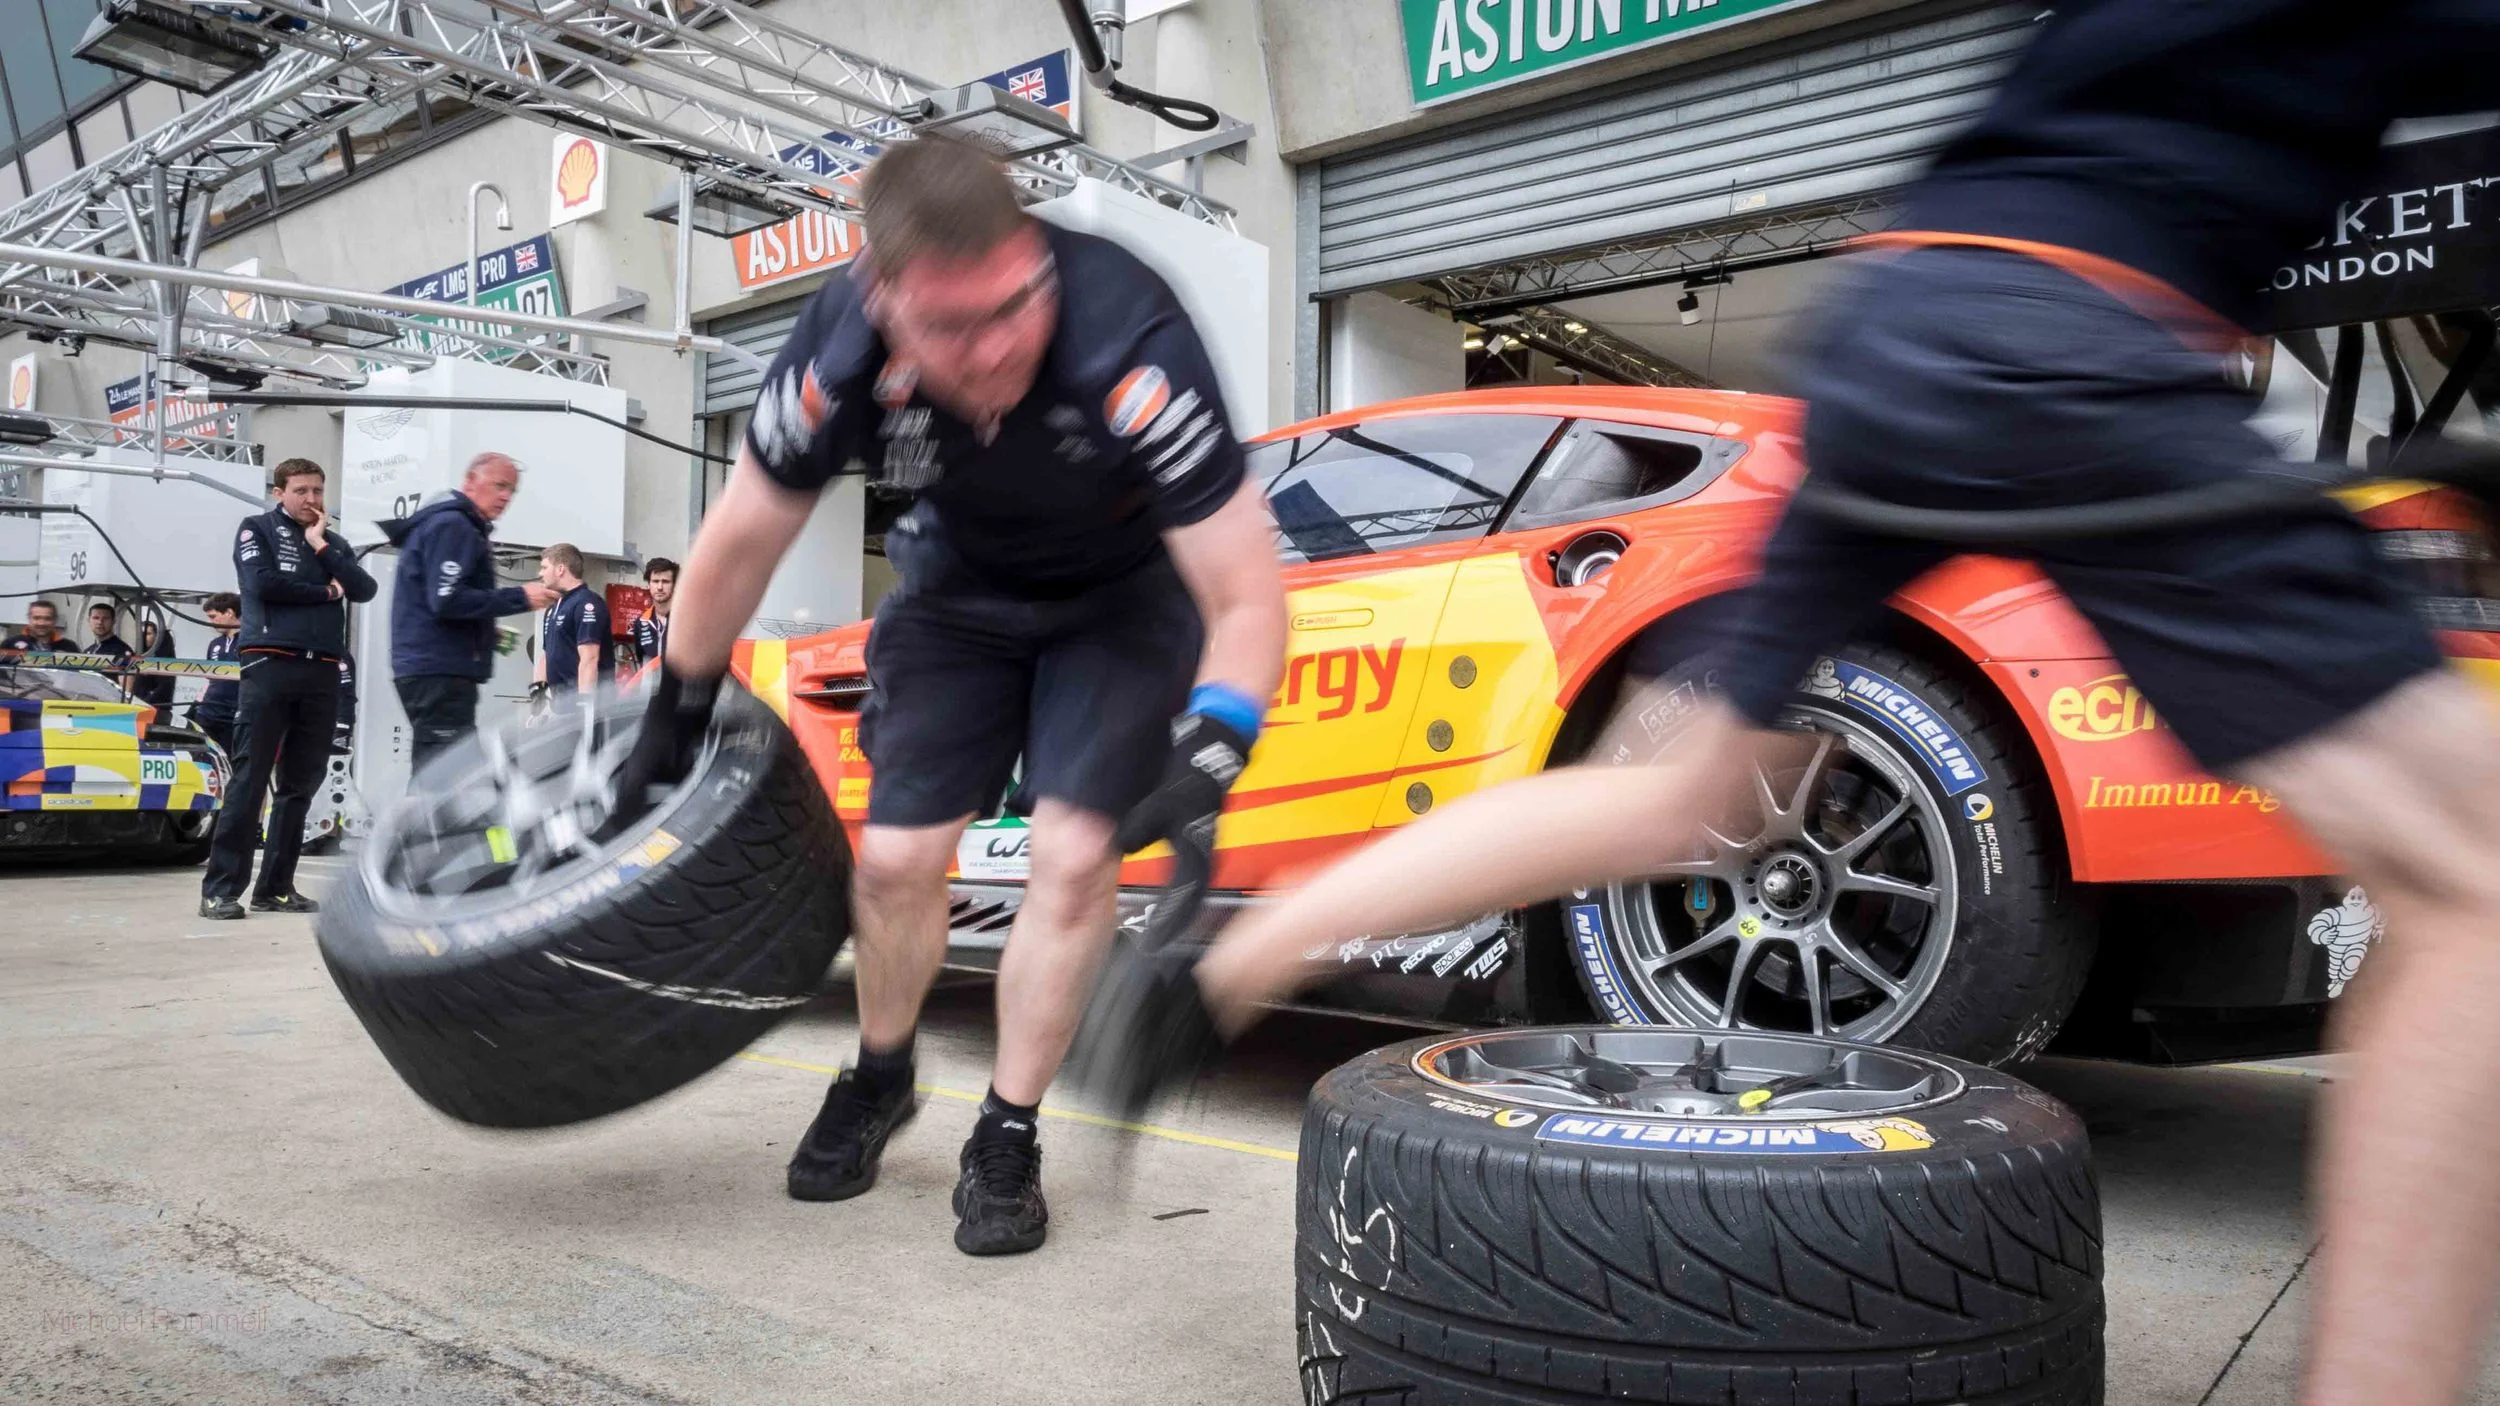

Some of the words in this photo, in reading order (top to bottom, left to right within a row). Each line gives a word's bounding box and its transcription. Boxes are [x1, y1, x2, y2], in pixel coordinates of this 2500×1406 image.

[2304, 176, 2500, 250] KET
[749, 208, 849, 280] ASTON
[481, 254, 508, 286] PRO
[2256, 245, 2434, 292] ONDON
[70, 551, 87, 581] 96
[18, 655, 127, 669] MARTIN
[128, 658, 233, 676] RACING
[1848, 675, 1976, 780] MICHELIN
[142, 759, 176, 780] PRO
[1973, 824, 1984, 843] Total
[1979, 844, 1991, 895] Performance
[1983, 822, 2003, 874] MICHELIN
[1400, 935, 1446, 975] RECARO
[1434, 938, 1473, 973] sparco
[1429, 1100, 1493, 1119] MICHELIN
[1551, 1118, 1817, 1146] MICHELIN
